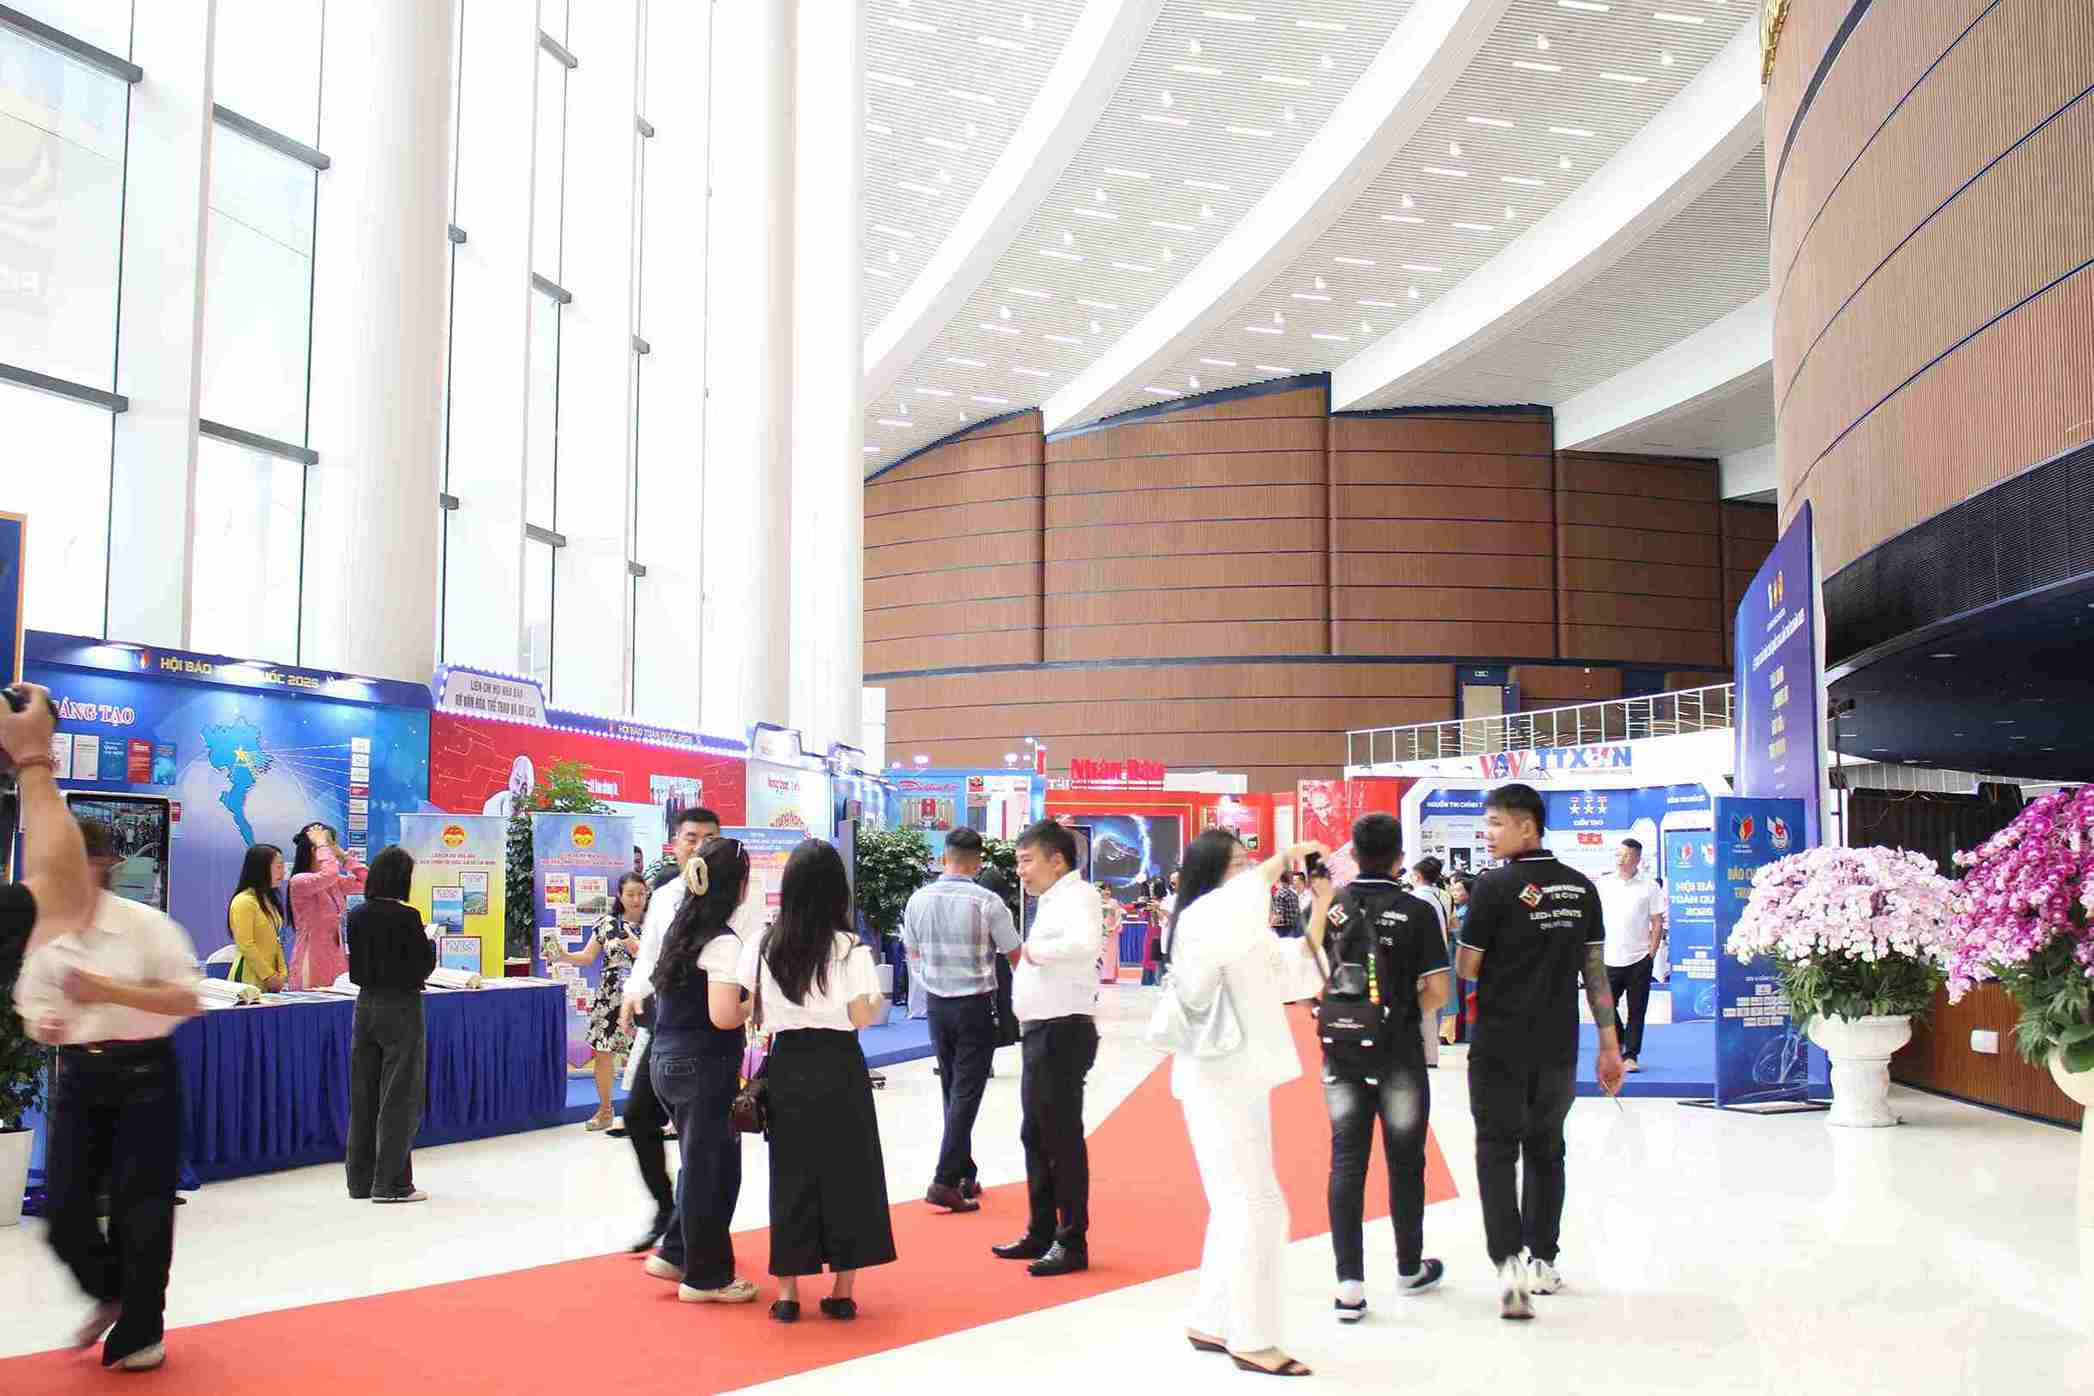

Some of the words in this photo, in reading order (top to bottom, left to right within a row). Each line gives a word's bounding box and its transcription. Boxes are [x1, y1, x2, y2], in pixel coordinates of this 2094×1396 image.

[160, 656, 183, 672] HỘI
[98, 704, 136, 726] TẠO
[1479, 751, 1529, 780] VOV
[1696, 879, 1714, 892] BÁ
[1699, 895, 1715, 905] QU
